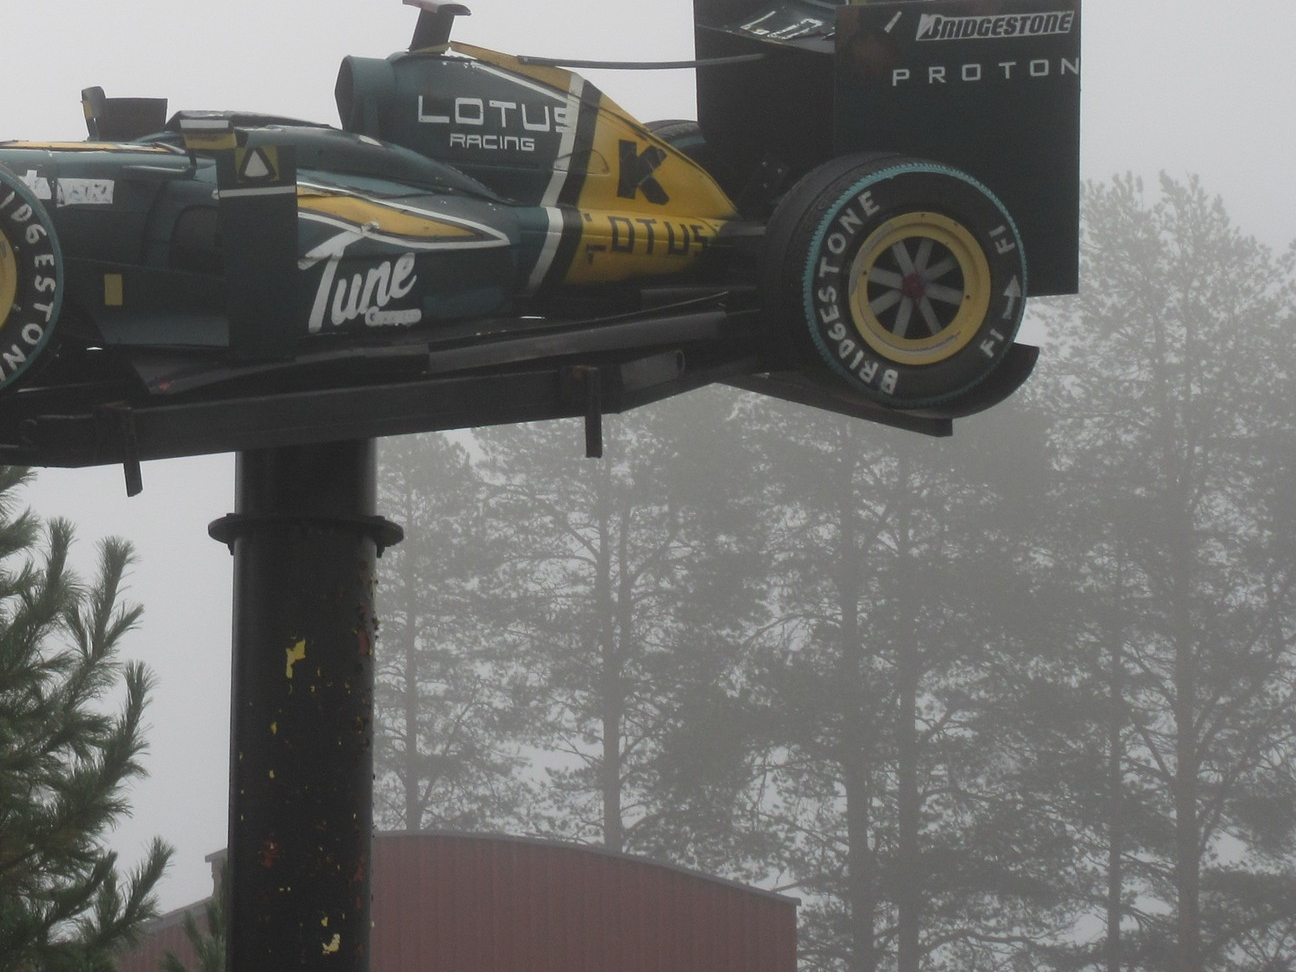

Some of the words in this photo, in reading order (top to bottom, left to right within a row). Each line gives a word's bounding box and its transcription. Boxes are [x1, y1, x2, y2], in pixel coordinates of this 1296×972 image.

[918, 13, 1073, 40] BRIDGESTONE
[892, 57, 1079, 86] PROTON
[418, 95, 571, 133] LOTUS
[450, 133, 535, 152] RACING
[617, 139, 670, 205] K
[298, 226, 417, 333] Tune
[818, 190, 898, 395] BRIDGESTONE
